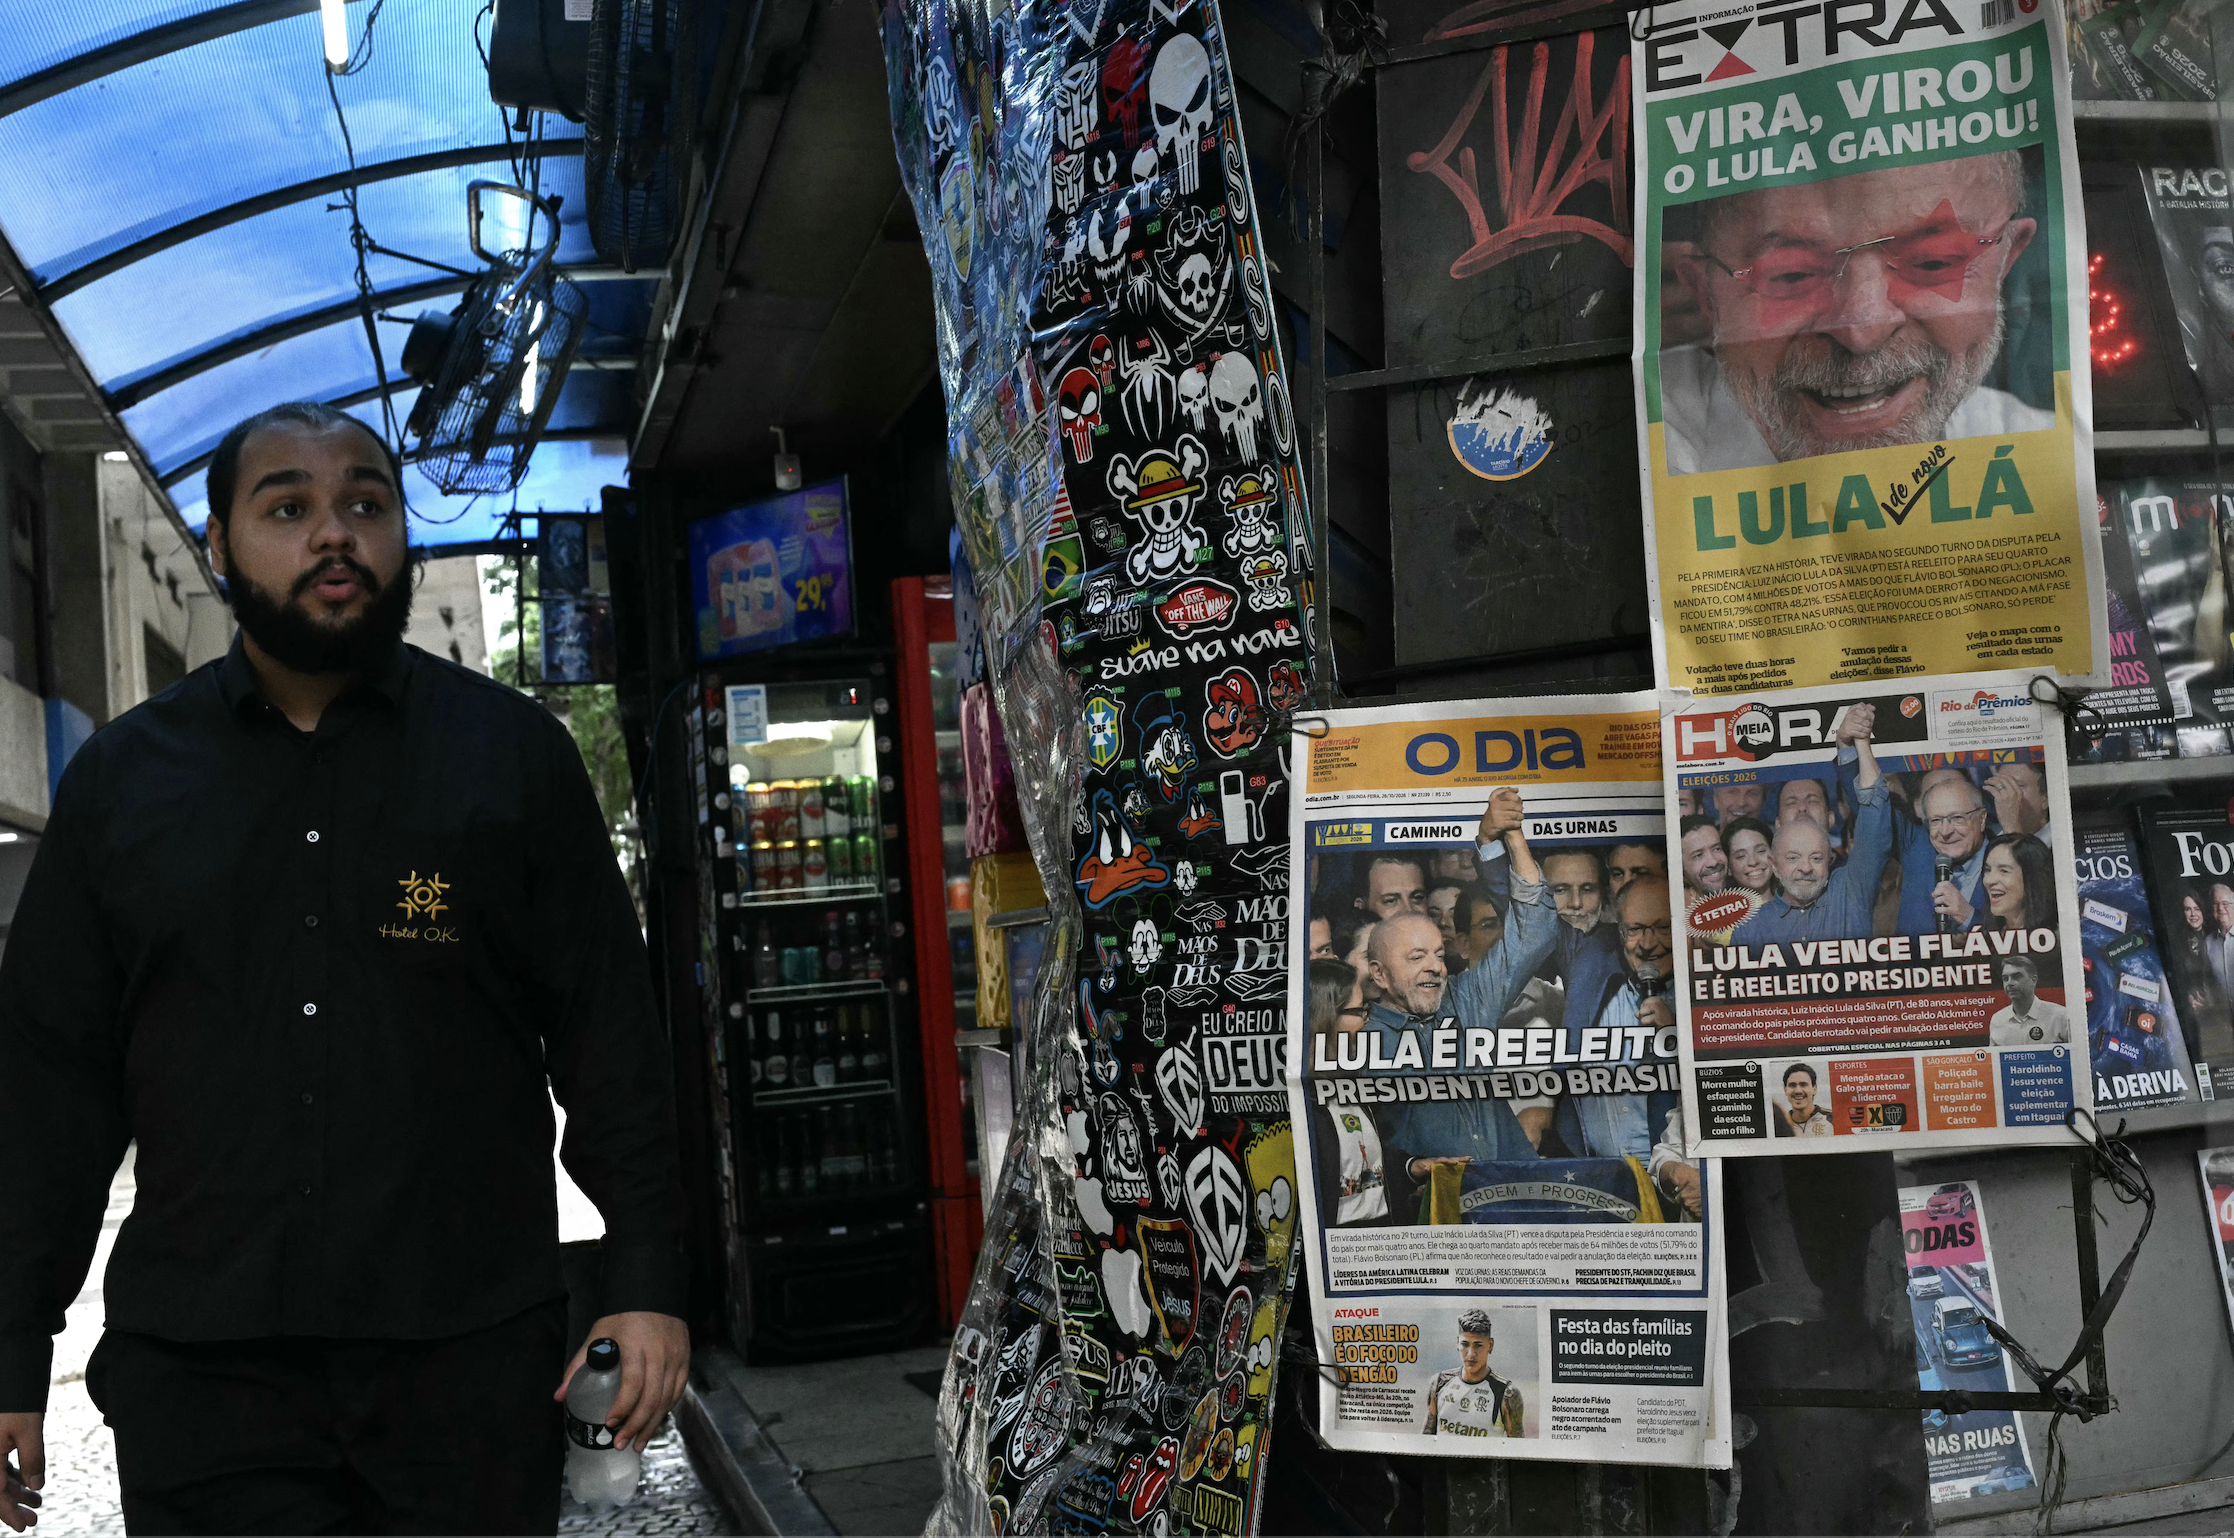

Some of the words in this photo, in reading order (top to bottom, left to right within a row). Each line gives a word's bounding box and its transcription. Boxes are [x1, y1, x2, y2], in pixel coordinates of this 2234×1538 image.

[1699, 4, 1754, 22] INFORMAÇÃO
[1645, 0, 1965, 93] EXTRA
[2153, 43, 2216, 100] BRASILEIRÃO
[2171, 48, 2207, 81] 2026
[1666, 92, 1824, 155] VIRA,
[1837, 45, 2034, 120] VIROU
[1201, 136, 1216, 152] G19
[1663, 164, 1695, 194] O
[1706, 141, 1817, 188] LULA
[1828, 98, 2040, 165] GANHOU!
[1209, 204, 1226, 220] G20
[1146, 220, 1162, 235] P20
[1888, 483, 1908, 507] de
[1911, 443, 1947, 484] novo
[1693, 474, 1886, 551] LULA
[1929, 444, 2034, 524] LÁ
[1194, 547, 1213, 563] M27
[1179, 587, 1206, 606] VANS
[1185, 603, 1206, 620] THE
[1103, 610, 1139, 637] JITSU
[1275, 620, 1290, 630] G10
[1966, 631, 1988, 641] Veja
[1999, 628, 2028, 639] mapa
[2030, 625, 2052, 634] com
[1966, 637, 2013, 651] resultado
[2014, 633, 2033, 645] das
[2034, 634, 2063, 644] urnas
[2109, 631, 2137, 657] MY
[1100, 646, 1180, 680] suave
[1185, 639, 1226, 663] na
[1231, 624, 1301, 655] nave
[1995, 647, 2019, 657] cada
[2021, 646, 2054, 655] estado
[2111, 660, 2150, 687] RDS
[1905, 699, 1919, 711] 2,00
[1941, 700, 1962, 712] Rio
[1978, 695, 2033, 710] Prêmios
[1092, 724, 1107, 735] CBF
[1736, 722, 1771, 736] MEIA
[1405, 732, 1460, 776] O
[1250, 775, 1266, 787] G83
[1683, 774, 1730, 787] ELEIÇÕES
[1733, 772, 1757, 783] 2026
[1305, 794, 1340, 803] odia.com.br
[1390, 826, 1462, 839] CAMINHO
[1533, 822, 1562, 836] DAS
[1566, 820, 1617, 834] URNAS
[2075, 855, 2133, 883] cios
[1260, 872, 1289, 891] NAS
[1235, 895, 1290, 924] MÃO
[1693, 910, 1703, 926] É
[1703, 898, 1748, 921] TETRA!
[2089, 906, 2116, 922] Braskem
[378, 923, 418, 939] Hotel
[424, 927, 460, 943] O.K.
[1192, 920, 1212, 933] NAS
[1262, 921, 1286, 941] DE
[1177, 935, 1218, 955] MÃOS
[1692, 943, 1786, 974] LULA
[1791, 935, 1913, 967] VENCE
[1918, 923, 2056, 959] FLÁVIO
[1192, 954, 1208, 966] DE
[1230, 937, 1289, 974] DEU
[1171, 963, 1221, 988] DEUS
[1695, 980, 1708, 1000] E
[1713, 972, 1726, 999] É
[1733, 972, 1841, 998] REELEITO
[1844, 963, 1992, 992] PRESIDENTE
[1222, 1004, 1236, 1014] G40
[1202, 1012, 1220, 1035] EU
[1225, 1009, 1272, 1034] CREIO
[2141, 1019, 2151, 1029] oi
[1314, 1030, 1424, 1072] LULA
[1431, 1017, 1458, 1068] É
[1464, 1026, 1678, 1066] REELEITO
[2120, 1042, 2140, 1055] CASAS
[1926, 1056, 1940, 1065] SÃO
[1941, 1056, 1973, 1065] GONÇALO
[1976, 1051, 1985, 1060] 10
[2004, 1053, 2036, 1061] PREFEITO
[2119, 1048, 2138, 1060] BAHIA
[1699, 1068, 1723, 1077] BÚZIOS
[1747, 1063, 1756, 1072] 10
[1834, 1062, 1867, 1070] ESPORTES
[1938, 1068, 1978, 1079] Poliçada
[2010, 1065, 2062, 1075] Haroldinho
[1315, 1074, 1513, 1105] PRESIDENTE
[1514, 1071, 1563, 1098] DO
[1568, 1064, 1682, 1096] BRASIL
[1701, 1081, 1727, 1089] Morre
[1728, 1079, 1757, 1088] mulher
[1840, 1073, 1874, 1084] Mengão
[1875, 1073, 1898, 1081] ataca
[1934, 1082, 1960, 1090] barra
[1960, 1079, 1984, 1088] baile
[2010, 1078, 2035, 1086] Jesus
[2036, 1078, 2064, 1086] vence
[2096, 1071, 2112, 1102] À
[2112, 1068, 2189, 1097] DERIVA
[1706, 1091, 1755, 1102] esfaqueada
[1836, 1084, 1856, 1093] Galo
[1856, 1085, 1878, 1093] para
[1878, 1083, 1910, 1091] retomar
[2021, 1090, 2055, 1099] eleição
[1211, 1095, 1228, 1113] DO
[1857, 1093, 1896, 1103] liderança
[1933, 1092, 1974, 1103] irregular
[1716, 1103, 1752, 1112] caminho
[1869, 1106, 1882, 1124] X
[1940, 1105, 1970, 1113] Morro
[1970, 1103, 1982, 1112] do
[2009, 1101, 2068, 1112] suplementar
[1714, 1115, 1726, 1123] da
[1726, 1115, 1751, 1123] escola
[1947, 1117, 1977, 1125] Castro
[2031, 1112, 2065, 1124] Itaguaí
[1252, 1123, 1265, 1133] G51
[1735, 1126, 1755, 1135] filho
[1108, 1179, 1149, 1199] JESUS
[1463, 1185, 1519, 1209] ORDEM
[1528, 1186, 1534, 1195] E
[1151, 1238, 1185, 1254] Veículo
[1904, 1221, 1975, 1255] ODAS
[1152, 1260, 1190, 1277] Protegido
[1160, 1290, 1192, 1316] Jesus
[1334, 1308, 1379, 1319] ATAQUE
[1332, 1324, 1419, 1343] BRASILEIRO
[1558, 1318, 1601, 1334] Festa
[1602, 1318, 1630, 1334] das
[1632, 1318, 1693, 1336] famílias
[1335, 1343, 1346, 1363] É
[1346, 1346, 1358, 1363] O
[1359, 1345, 1397, 1363] FOCO
[1398, 1345, 1418, 1363] DO
[1558, 1341, 1578, 1355] no
[1580, 1339, 1604, 1355] dia
[1606, 1339, 1626, 1355] do
[1628, 1339, 1672, 1358] pleito
[1338, 1363, 1398, 1385] MENGÃO
[1439, 1418, 1488, 1438] Betano
[1925, 1428, 1961, 1456] NAS
[1964, 1425, 2016, 1452] RUAS
